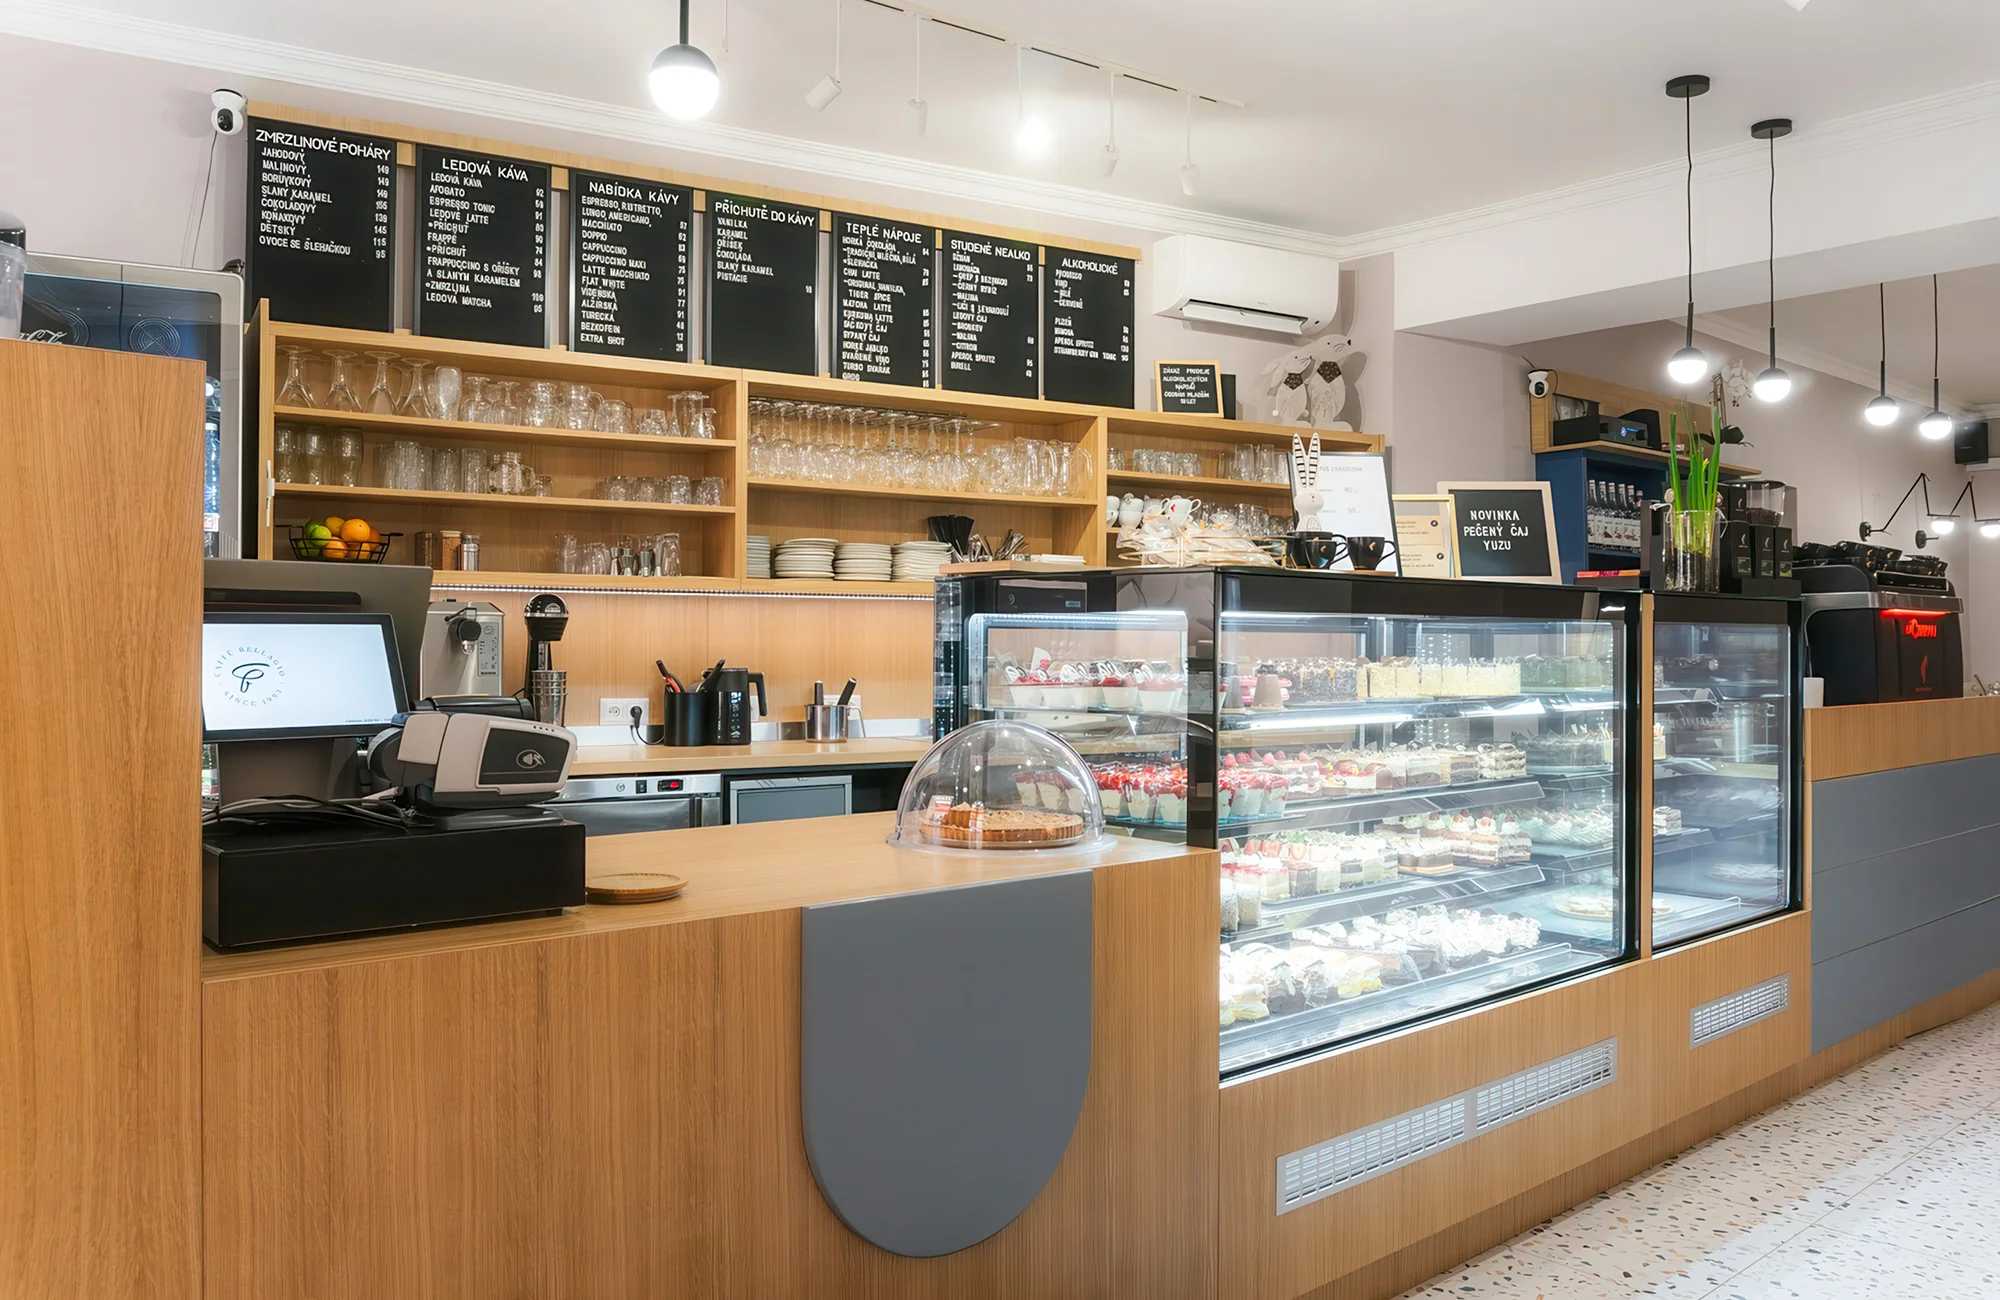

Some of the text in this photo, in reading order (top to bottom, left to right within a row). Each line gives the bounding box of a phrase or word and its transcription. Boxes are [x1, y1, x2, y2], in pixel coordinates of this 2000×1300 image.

[256, 129, 391, 160] ZMRZLINOVÉ POHÁRY
[377, 165, 390, 175] 149
[442, 158, 529, 182] LEDOVÁ KÁVA
[291, 189, 333, 203] KARAMEL
[589, 181, 680, 205] NABÍDKA KÁVY
[466, 213, 489, 225] LATTE
[715, 198, 815, 227] PŘÍCHUTĚ DO KÁVY
[581, 230, 608, 241] DOPPIO
[846, 222, 922, 244] TEPLÉ NÁPOJE
[259, 235, 289, 248] OVOCE
[289, 239, 301, 250] SE
[582, 241, 628, 256] CAPPUCCINO
[951, 239, 1031, 261] STUDENÉ NEALKO
[427, 256, 481, 271] FRAPPUCCINO
[483, 263, 489, 272] S
[581, 253, 627, 267] CAPPUCCINO
[1061, 257, 1119, 275] ALKOHOLICKÉ
[426, 268, 433, 278] A
[582, 264, 606, 276] LATTE
[716, 271, 748, 283] PISTACIE
[580, 332, 604, 344] EXTRA
[1470, 510, 1520, 521] NOVINKA
[1483, 540, 1511, 551] YUZU
